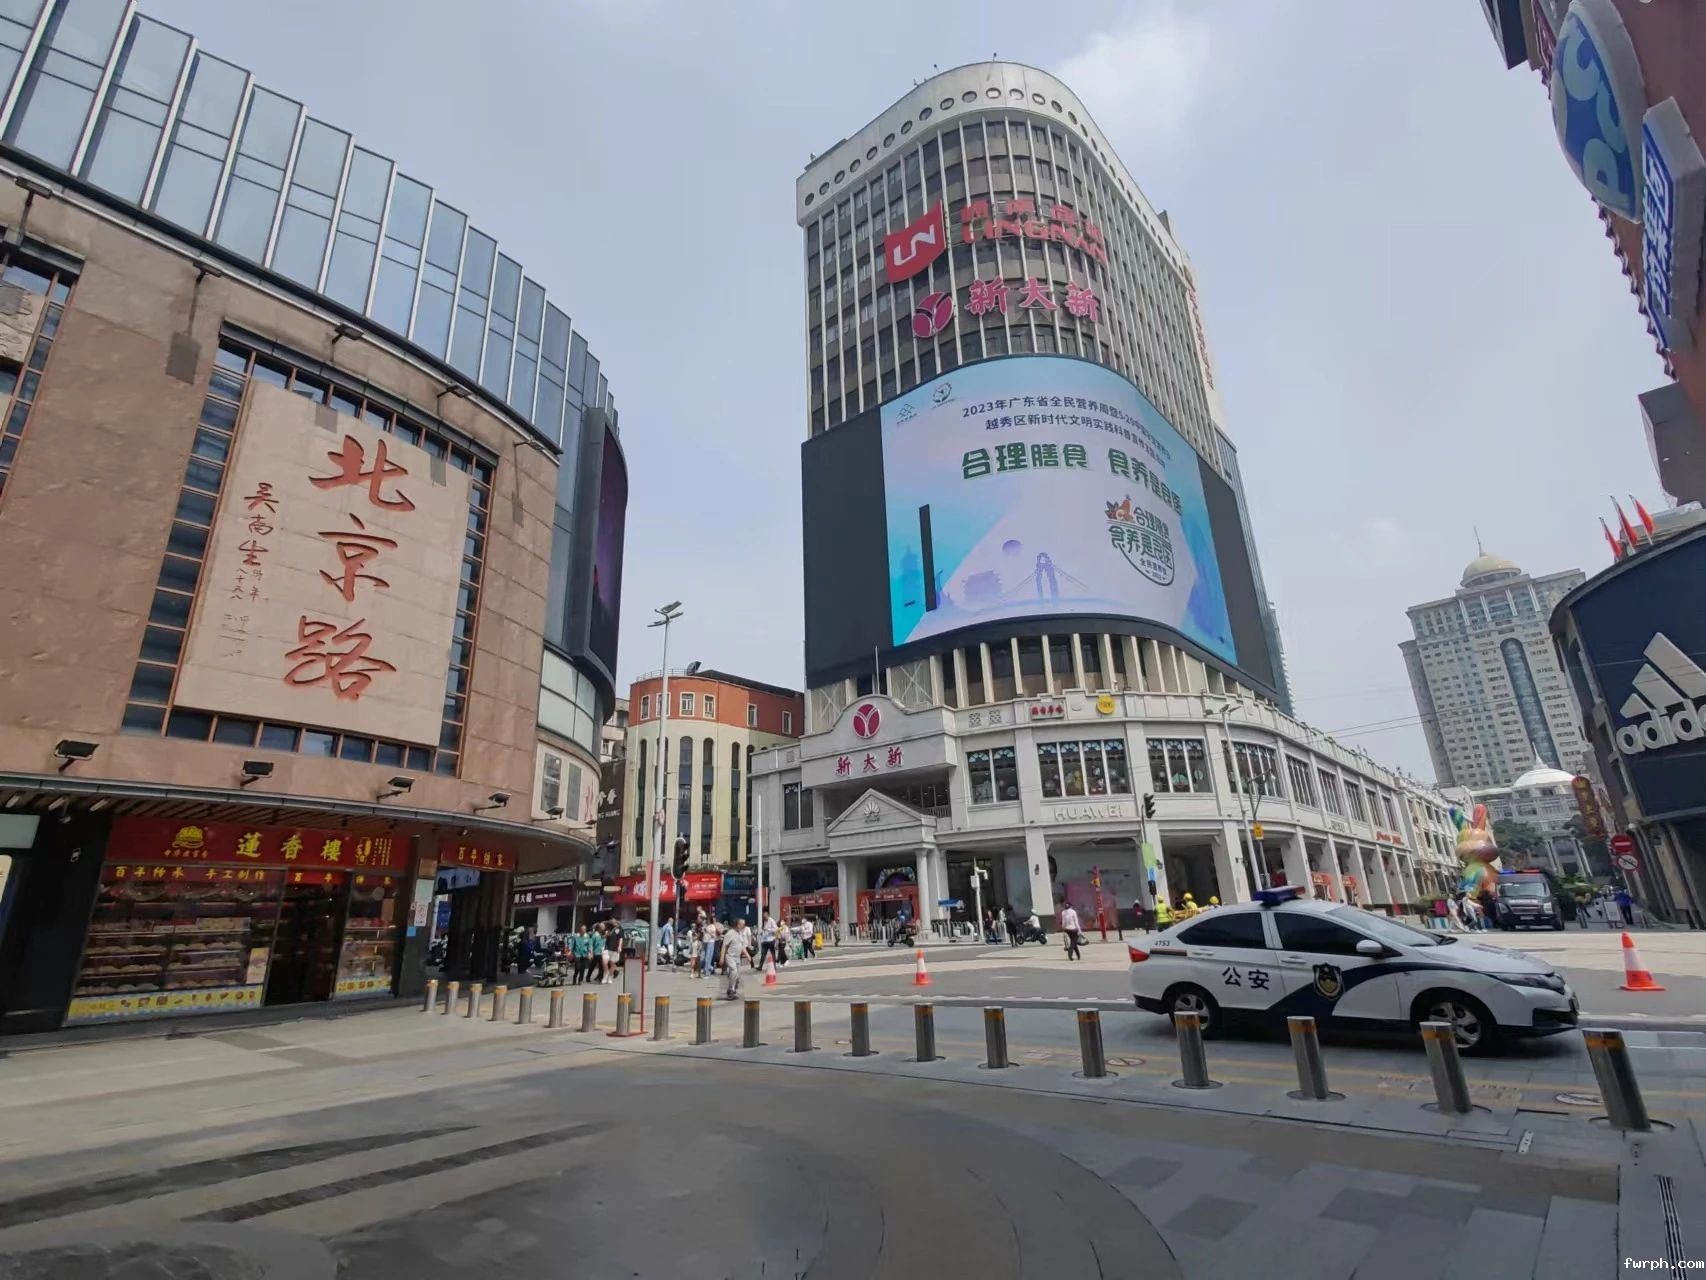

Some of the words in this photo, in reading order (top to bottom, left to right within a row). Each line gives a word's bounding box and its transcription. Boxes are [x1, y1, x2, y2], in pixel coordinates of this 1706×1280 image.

[964, 275, 1099, 323] 新大新
[961, 441, 1088, 479] 合理膳食
[284, 434, 416, 701] 北京路
[1615, 699, 1706, 754] adid
[835, 746, 904, 777] 新大新
[1053, 804, 1123, 822] HUAWEI
[1222, 967, 1270, 990] 公安
